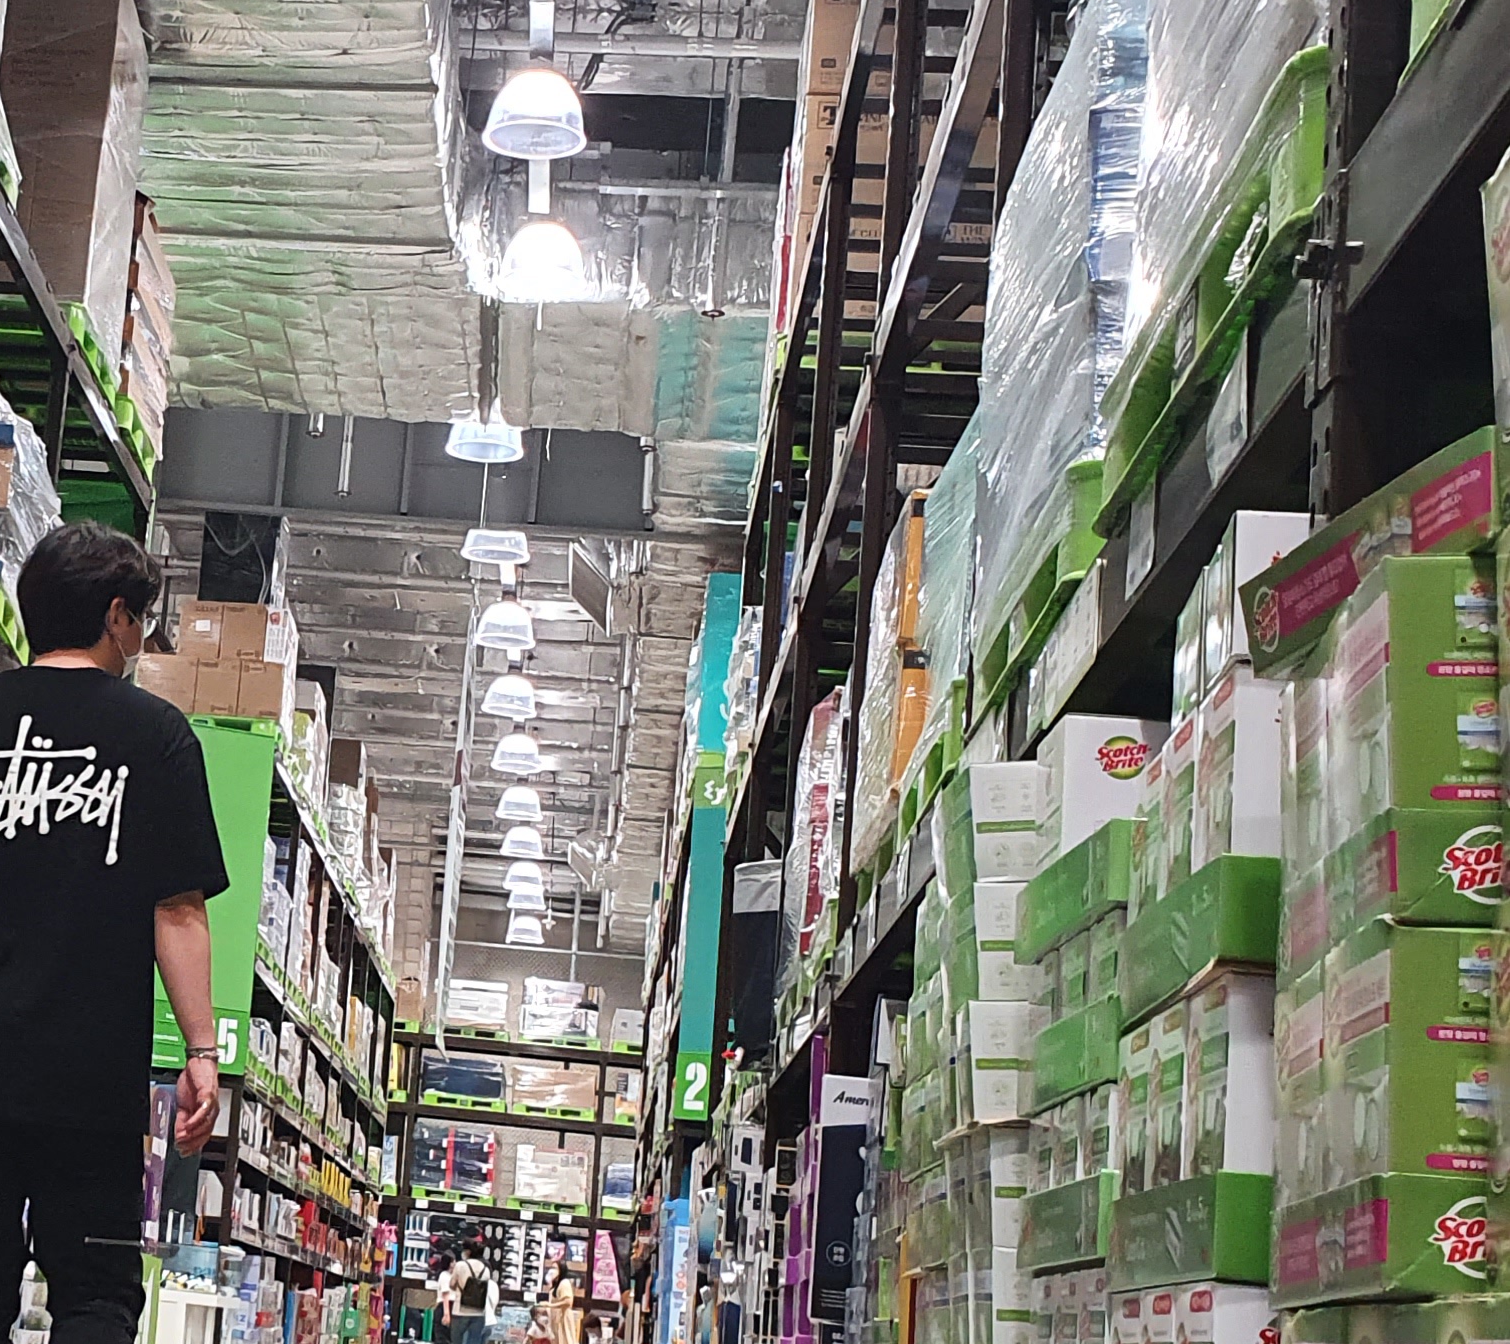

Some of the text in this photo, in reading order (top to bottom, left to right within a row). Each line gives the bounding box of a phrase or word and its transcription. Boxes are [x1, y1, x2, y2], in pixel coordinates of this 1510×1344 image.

[1102, 756, 1145, 772] Brite
[1441, 841, 1503, 873] Scot
[1456, 867, 1503, 892] Bri
[681, 1061, 708, 1112] 2
